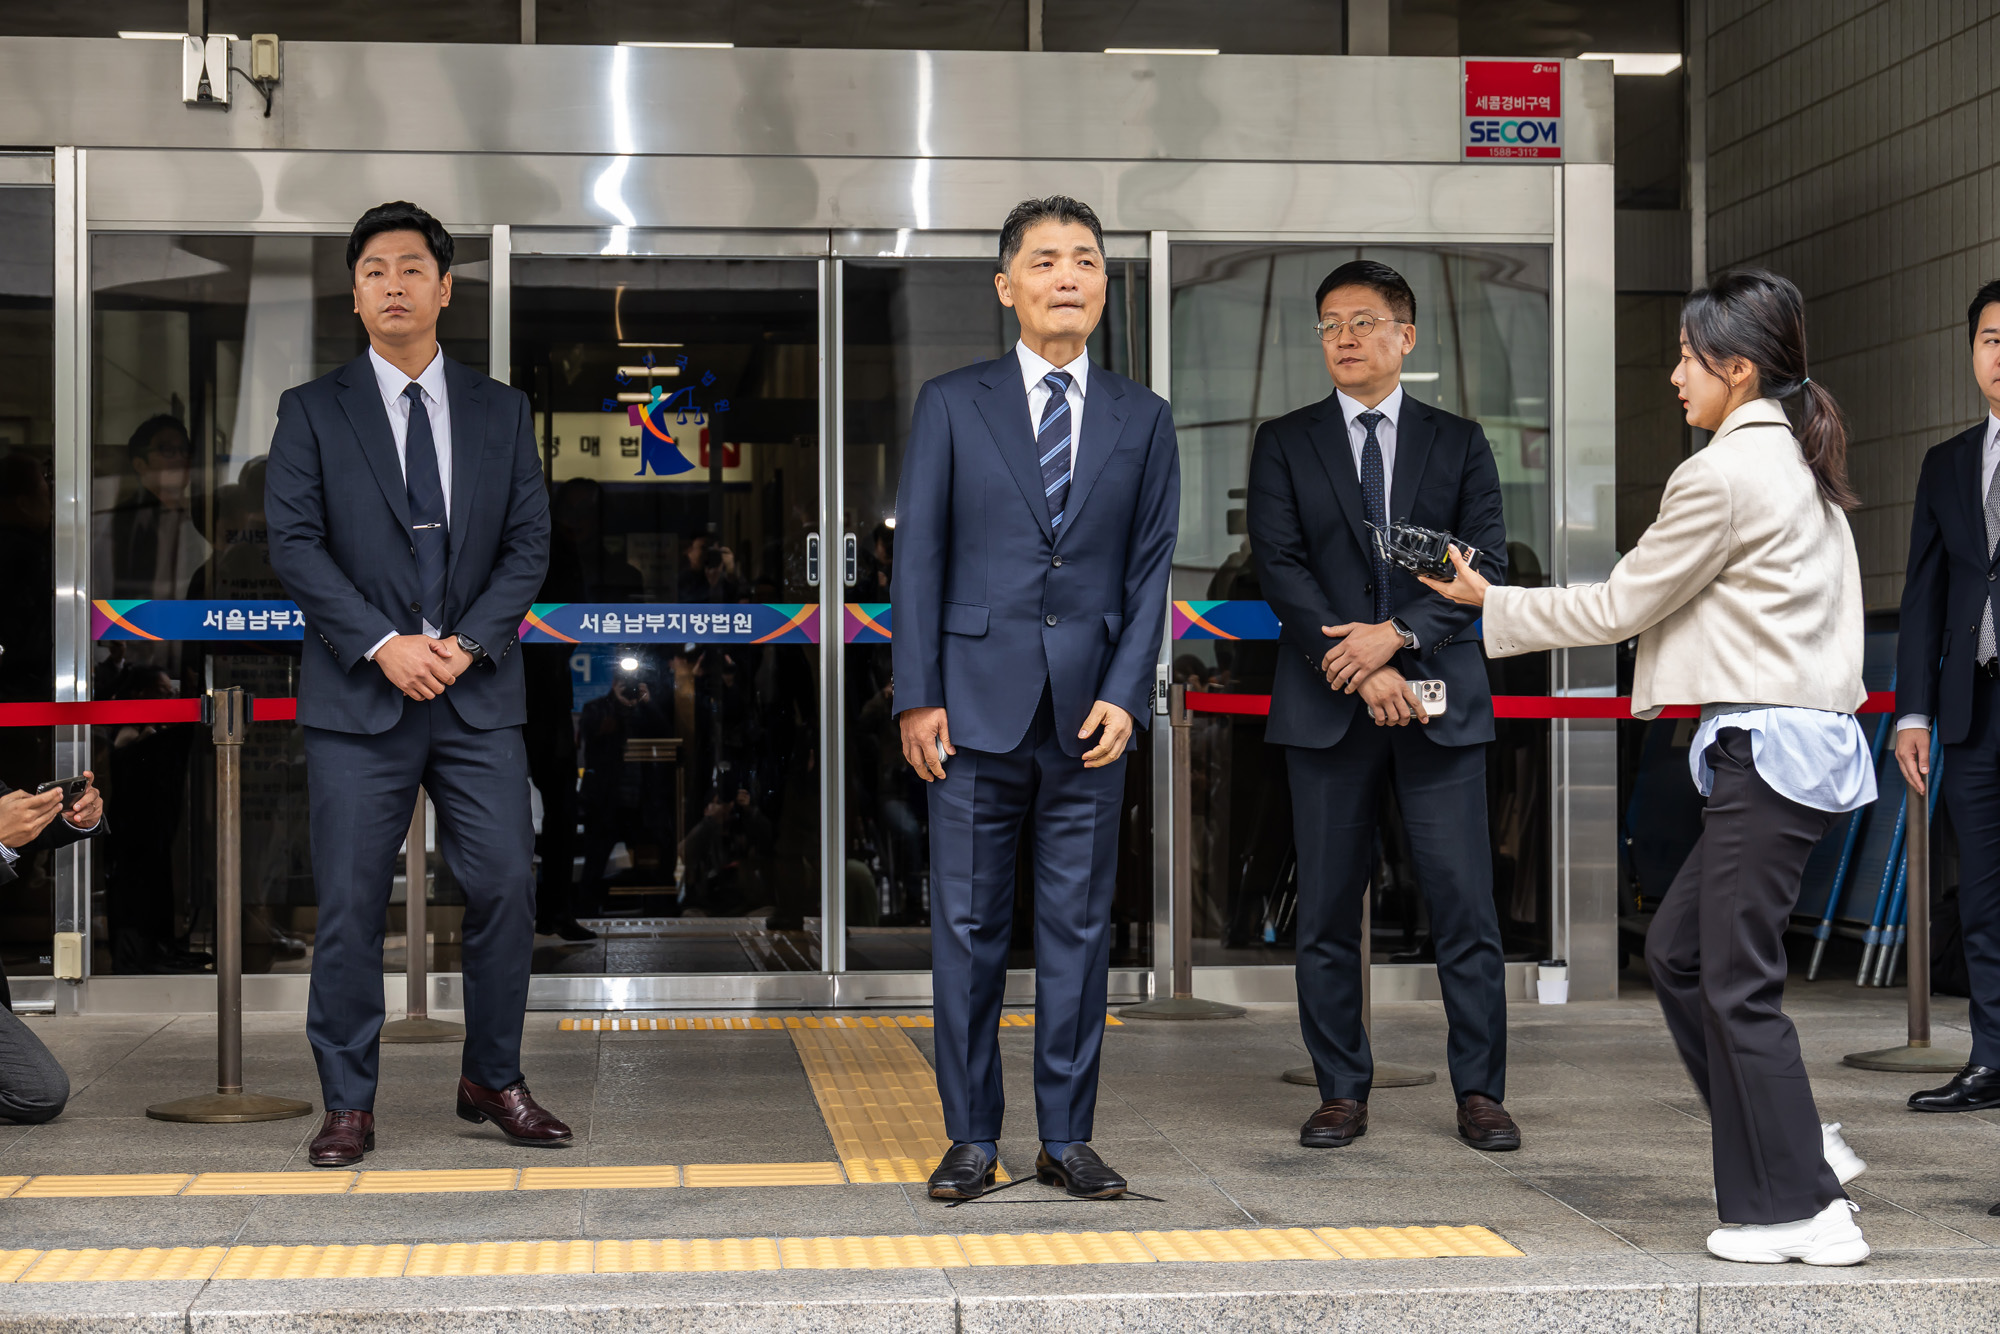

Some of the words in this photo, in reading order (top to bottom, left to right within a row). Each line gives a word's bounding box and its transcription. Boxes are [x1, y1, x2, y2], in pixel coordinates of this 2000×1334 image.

[1476, 95, 1550, 111] 세콤경비구역
[1469, 120, 1557, 144] SECOM
[1489, 147, 1539, 157] 1588-3112
[579, 612, 753, 634] 서울남부지방법원
